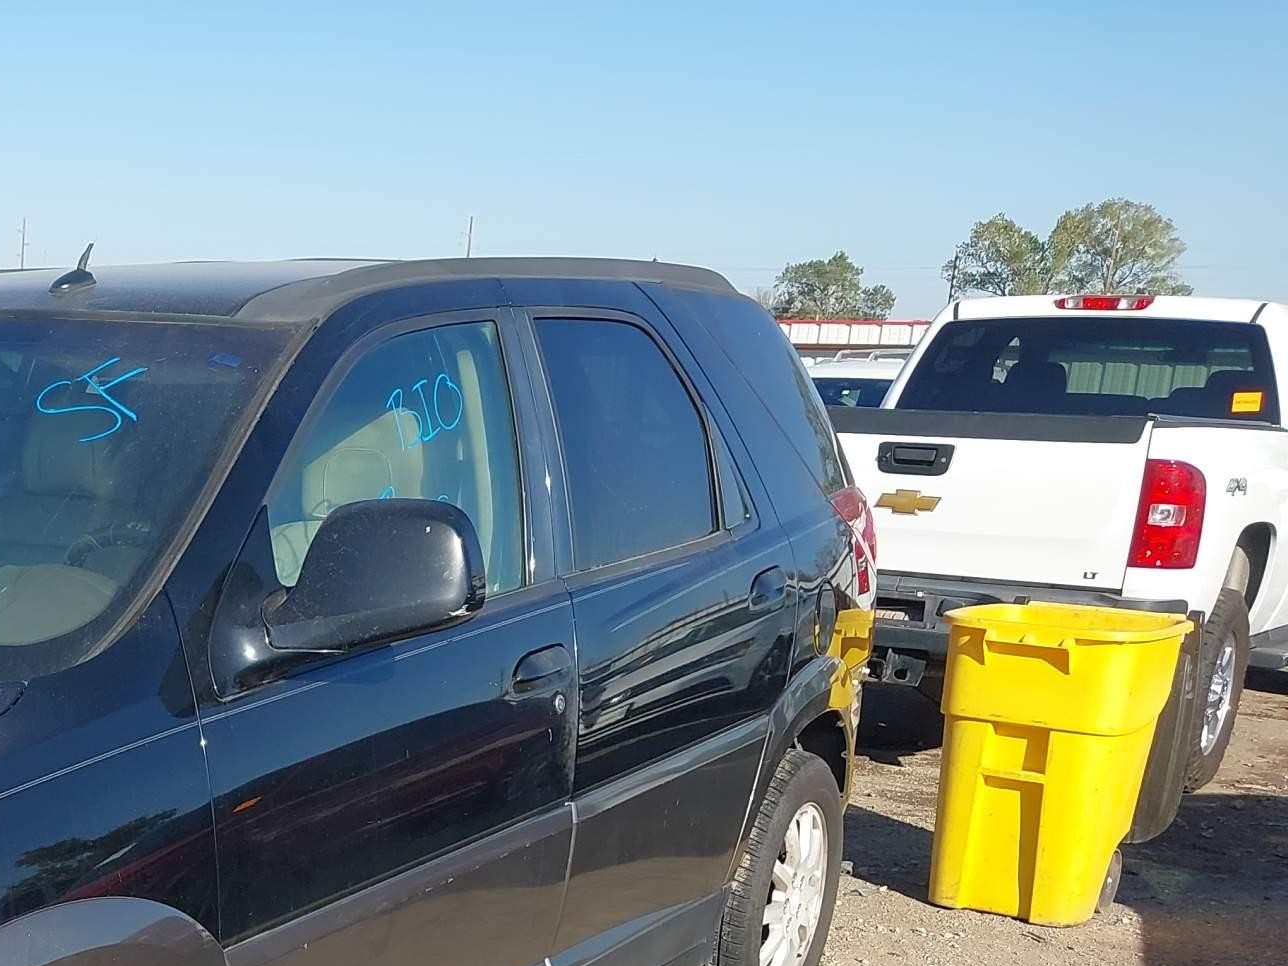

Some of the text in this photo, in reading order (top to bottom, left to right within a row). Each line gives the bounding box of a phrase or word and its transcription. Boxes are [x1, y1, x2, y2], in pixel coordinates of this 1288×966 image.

[385, 373, 463, 452] BIO
[1226, 477, 1248, 496] 4X4
[1083, 571, 1100, 581] LT
